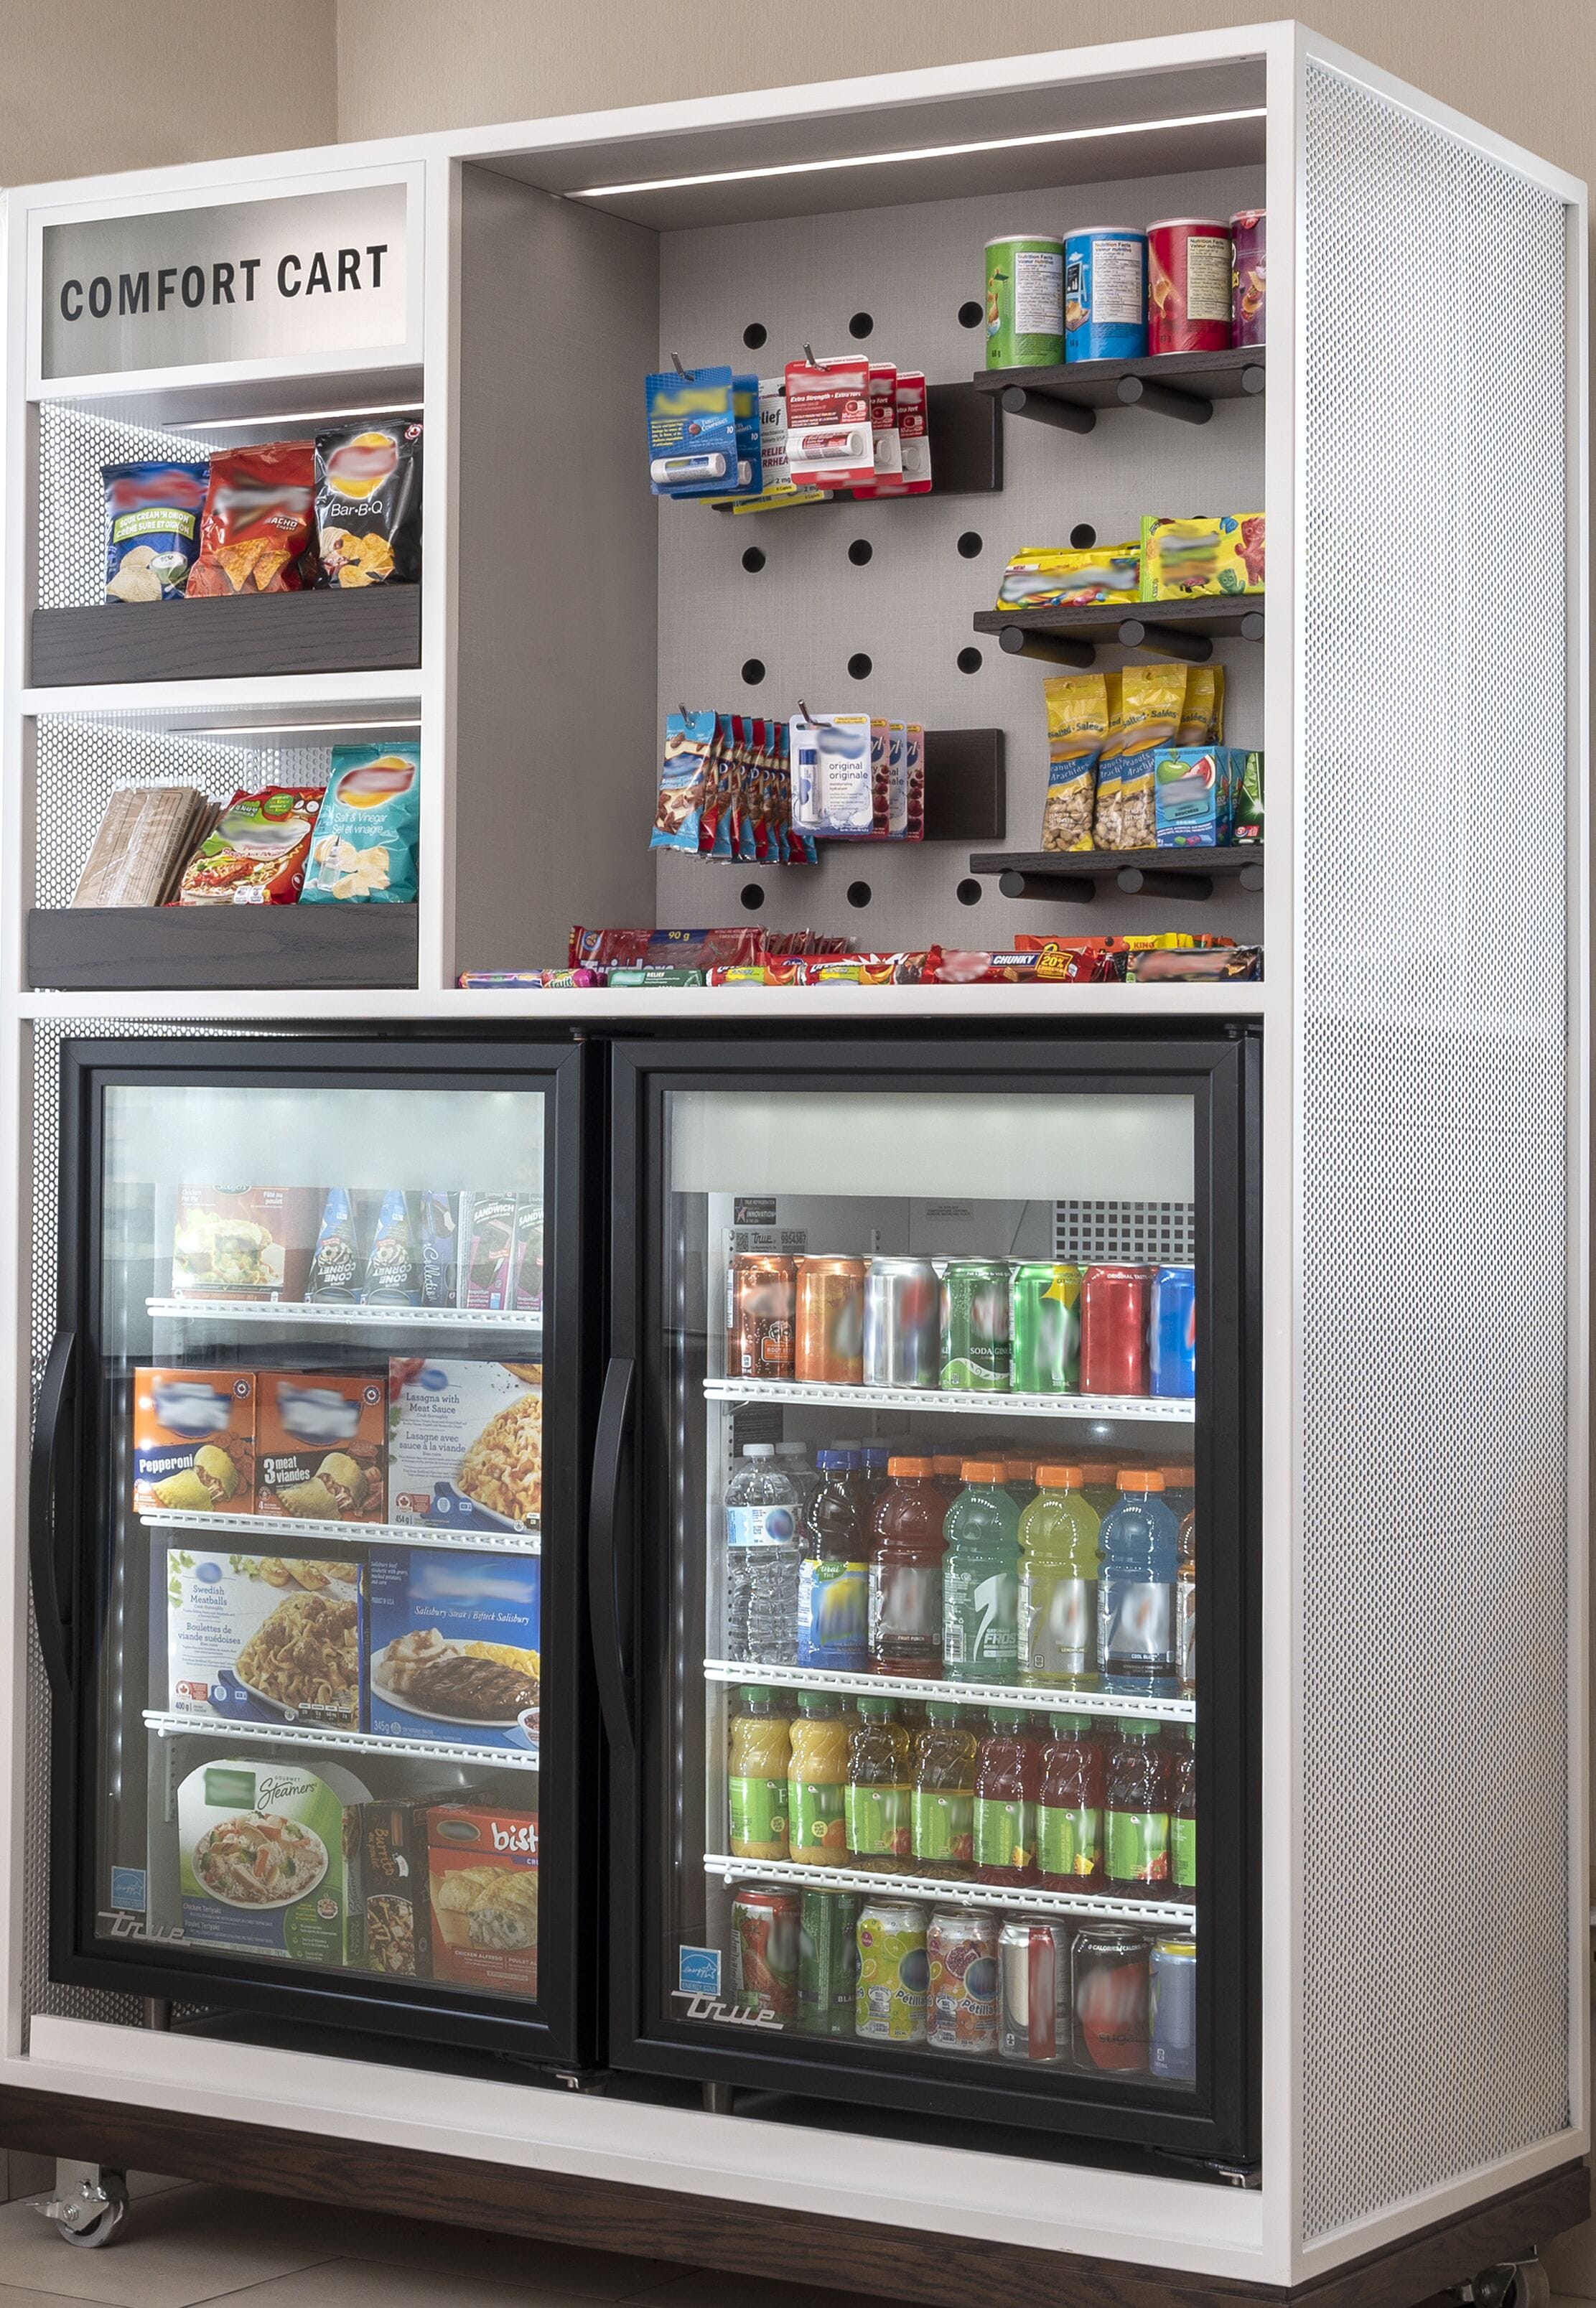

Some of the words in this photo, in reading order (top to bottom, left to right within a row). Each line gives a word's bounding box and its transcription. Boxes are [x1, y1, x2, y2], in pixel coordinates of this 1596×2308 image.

[60, 258, 261, 322] COMFORT
[277, 244, 388, 298] CART
[806, 394, 831, 403] Strength
[761, 409, 781, 425] lief
[727, 426, 734, 434] 10
[762, 457, 788, 467] RRHEA
[120, 516, 136, 528] SOUR
[136, 511, 159, 521] CREAM
[168, 512, 190, 523] ONION
[138, 521, 157, 531] SURE
[1109, 718, 1121, 727] ted
[1123, 753, 1150, 767] Peanuts
[829, 762, 863, 772] original
[829, 771, 868, 781] originale
[335, 813, 349, 823] Salt
[350, 813, 356, 822] &
[358, 812, 388, 826] Vinegar
[332, 825, 344, 834] Sel
[345, 825, 353, 834] et
[354, 825, 383, 835] vinaigre
[668, 931, 681, 940] 90
[683, 933, 689, 942] g
[993, 954, 1035, 964] CHUNKY
[1041, 955, 1064, 967] 20%
[474, 1203, 515, 1221] SANDWICH
[518, 1210, 543, 1227] SANDW
[751, 1231, 773, 1244] True
[318, 1261, 356, 1275] CORNET
[373, 1263, 411, 1276] CORNET
[324, 1271, 353, 1282] CONE
[379, 1274, 408, 1284] CONE
[406, 1392, 439, 1404] Lasagna
[442, 1394, 460, 1403] with
[409, 1403, 430, 1413] Meat
[432, 1404, 456, 1414] Sauce
[406, 1431, 439, 1442] Lasagne
[423, 1441, 427, 1450] à
[429, 1441, 437, 1450] la
[439, 1443, 466, 1453] viande
[139, 1455, 193, 1473] Pepperoni
[275, 1456, 297, 1470] meat
[263, 1458, 276, 1484] 3
[276, 1468, 311, 1483] viandes
[258, 1501, 264, 1510] 4
[395, 1514, 405, 1524] 454
[193, 1584, 225, 1596] Swedish
[190, 1595, 228, 1606] Meatballs
[414, 1605, 447, 1618] Salisbury
[472, 1611, 495, 1622] Bifteck
[496, 1612, 530, 1626] Salisbury
[186, 1622, 221, 1634] Boulettes
[223, 1625, 233, 1635] de
[178, 1632, 204, 1641] viande
[204, 1634, 241, 1645] suédoises
[984, 1633, 1017, 1644] FROS
[175, 1701, 185, 1711] 400
[258, 1777, 314, 1811] Steamers
[490, 1822, 538, 1853] bist
[183, 1902, 202, 1912] Chicken
[202, 1906, 222, 1915] Teriyaki
[454, 1950, 477, 1958] CHICKEN
[478, 1953, 503, 1961] ALFREDO
[682, 1982, 701, 1991] ENERGY
[701, 1984, 717, 1993] STAR
[895, 1990, 928, 2006] Pétilla
[671, 1991, 784, 2030] true
[961, 1999, 996, 2016] Pétilla
